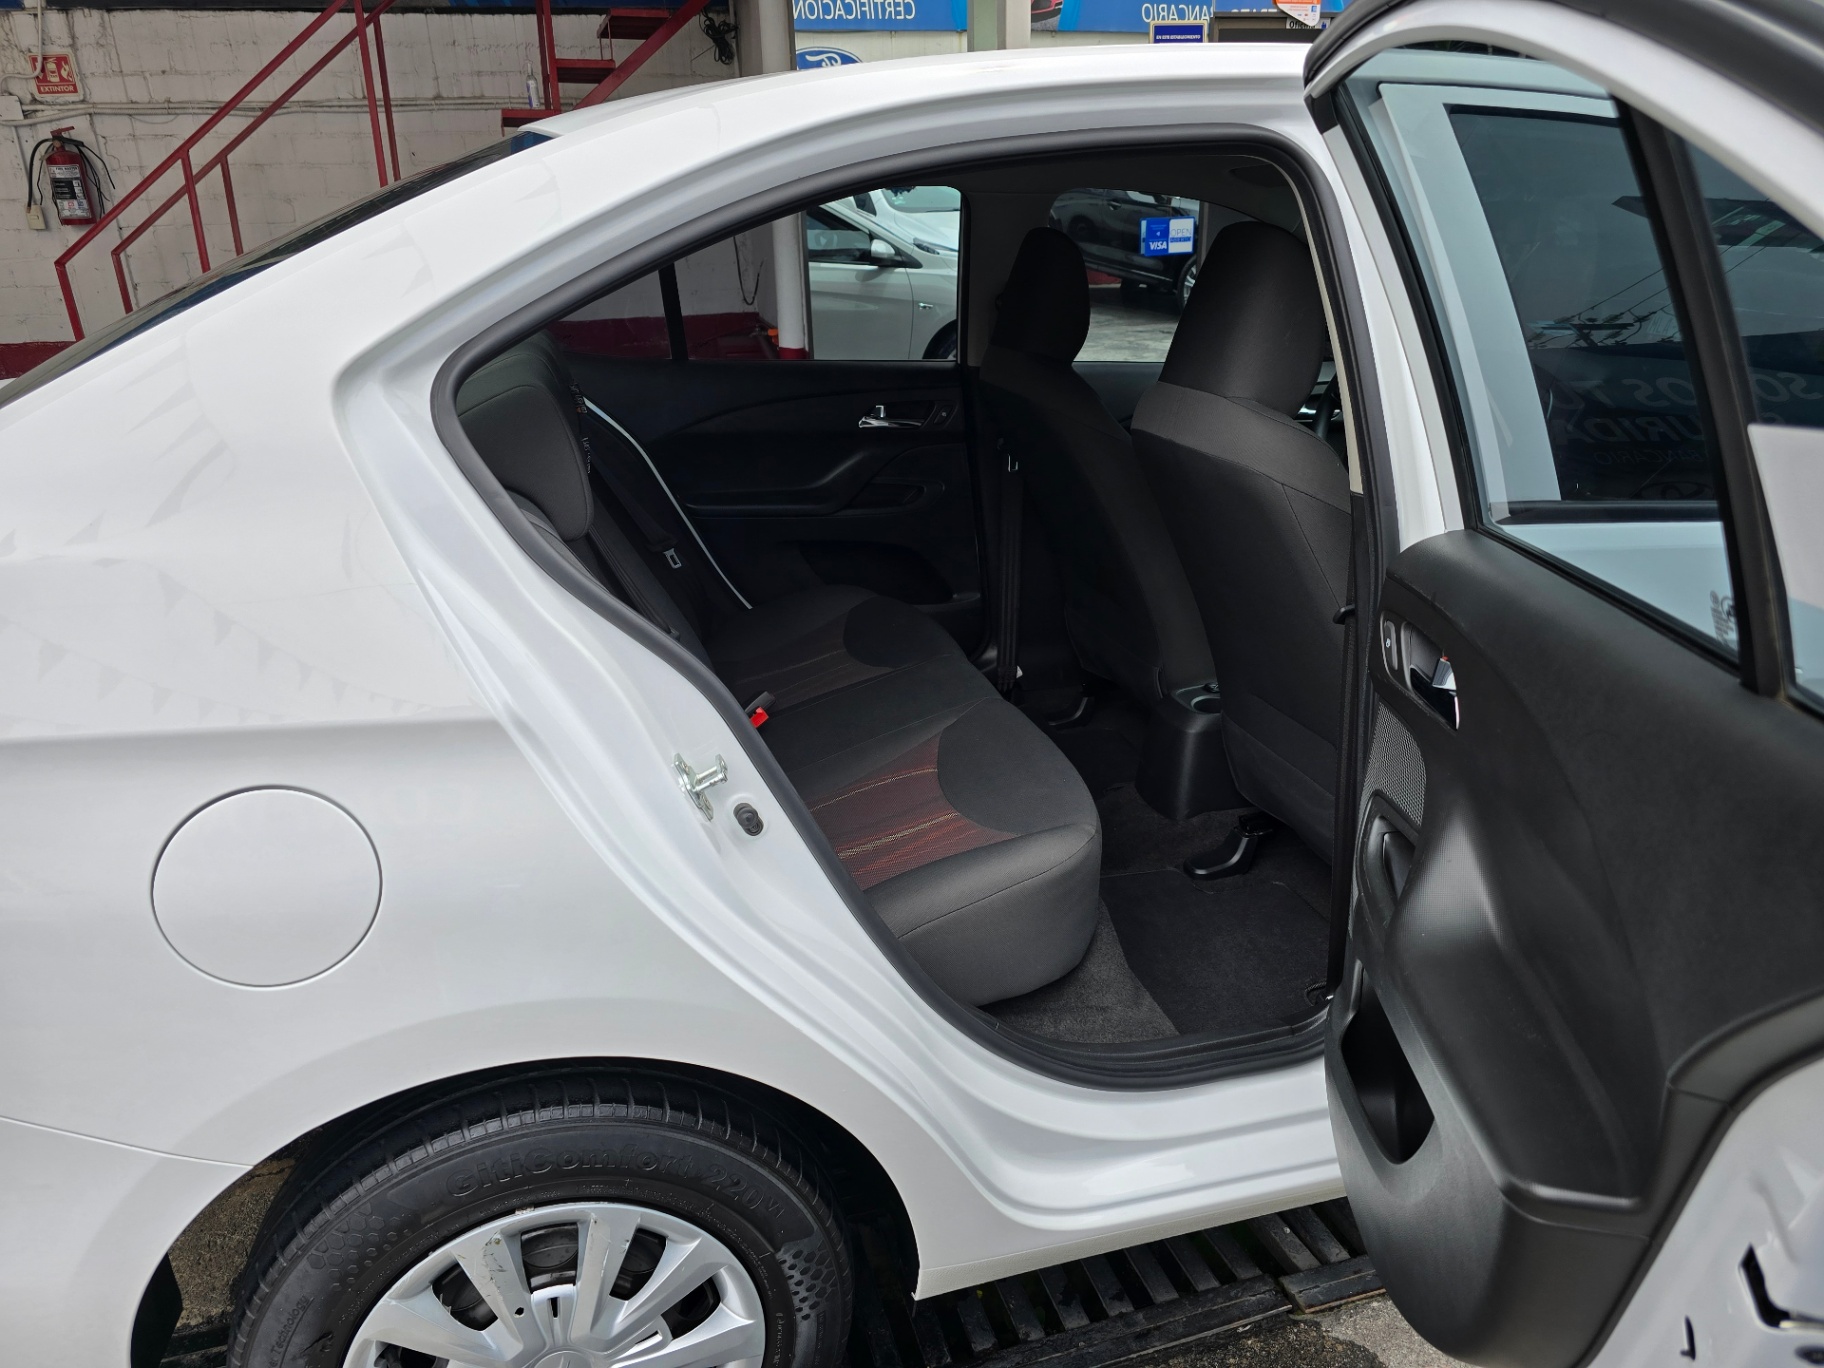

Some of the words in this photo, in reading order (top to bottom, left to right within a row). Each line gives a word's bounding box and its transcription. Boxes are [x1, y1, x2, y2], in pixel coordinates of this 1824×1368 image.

[1149, 241, 1167, 250] VISA
[1170, 228, 1192, 237] OPEN
[446, 1143, 694, 1197] GitiComfort
[701, 1163, 766, 1210] 220
[270, 1295, 310, 1355] Technology
